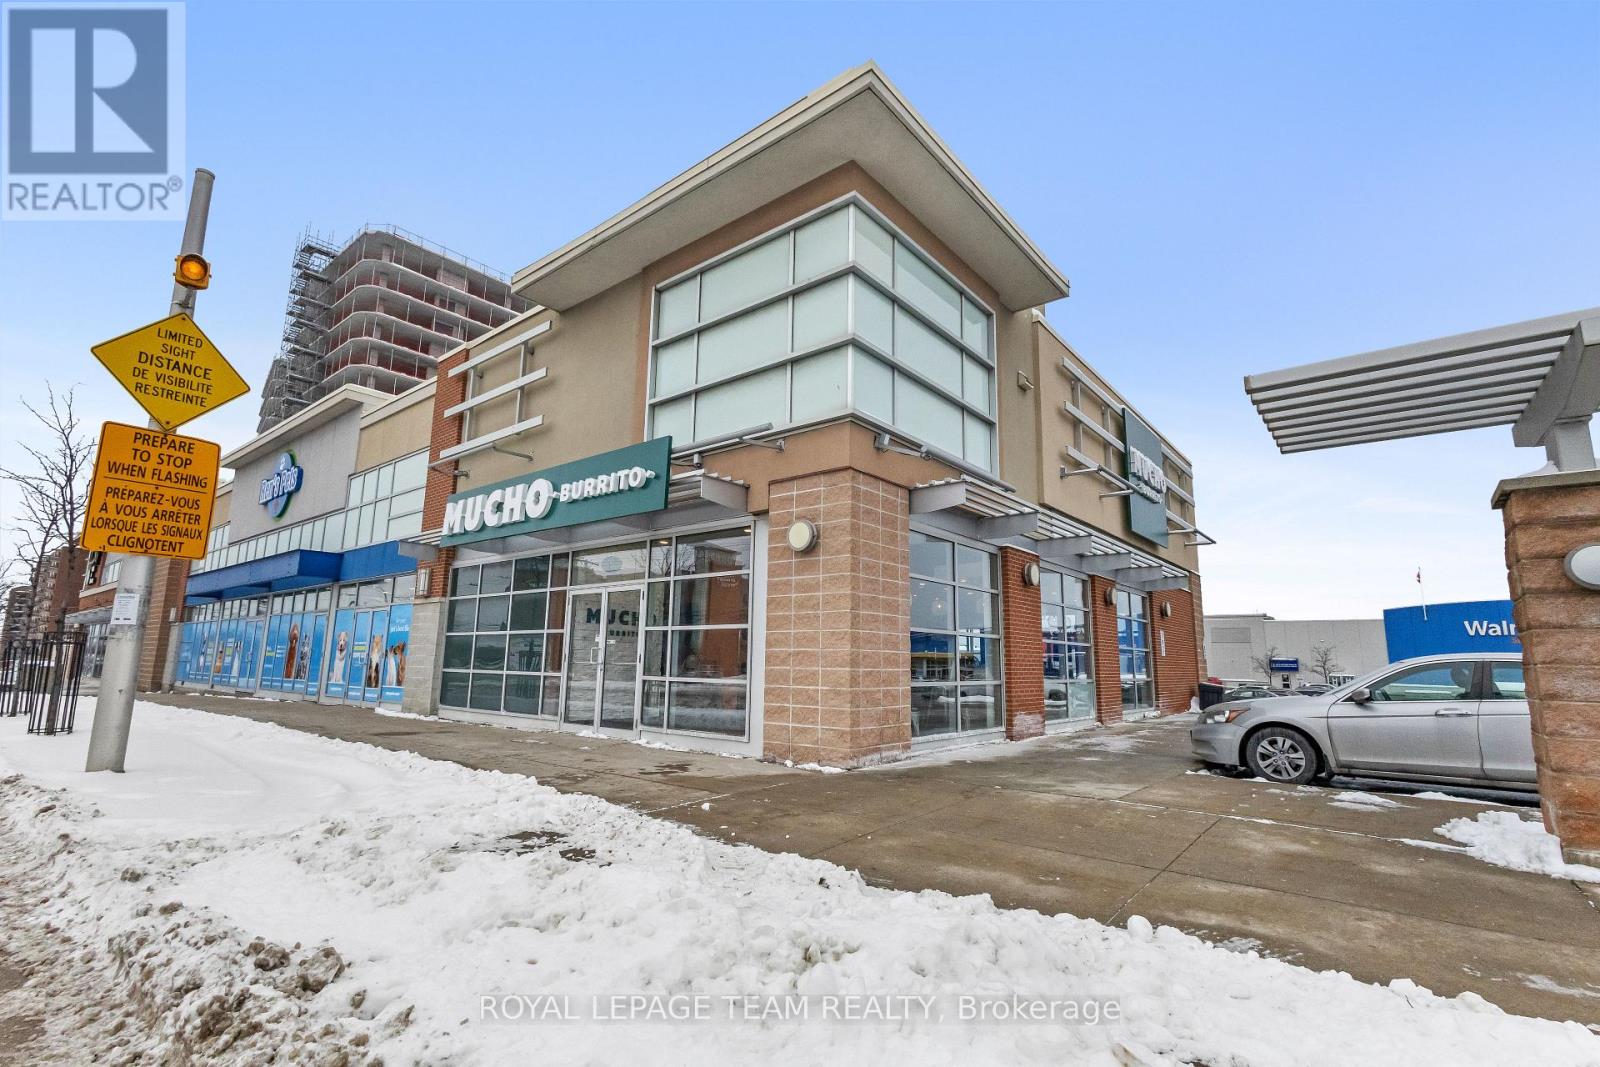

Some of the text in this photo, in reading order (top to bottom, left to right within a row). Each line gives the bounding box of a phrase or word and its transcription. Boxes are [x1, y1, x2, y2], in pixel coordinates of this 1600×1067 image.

[157, 327, 203, 348] LIMITED
[161, 343, 196, 360] SIGHT
[138, 351, 213, 381] DISTANCE
[132, 367, 213, 394] DE VISIBILITE
[135, 382, 207, 407] RESTREINTE
[133, 432, 196, 455] PREPARE
[132, 448, 193, 470] TO STOP
[107, 461, 208, 489] WHEN FLASHING
[98, 499, 202, 526] À VOUS ARRÊTER
[441, 466, 647, 536] MUCHO BURRITO
[91, 517, 203, 541] LORSQUE LES SIGNAUX
[107, 534, 185, 553] CLIGNOTENT
